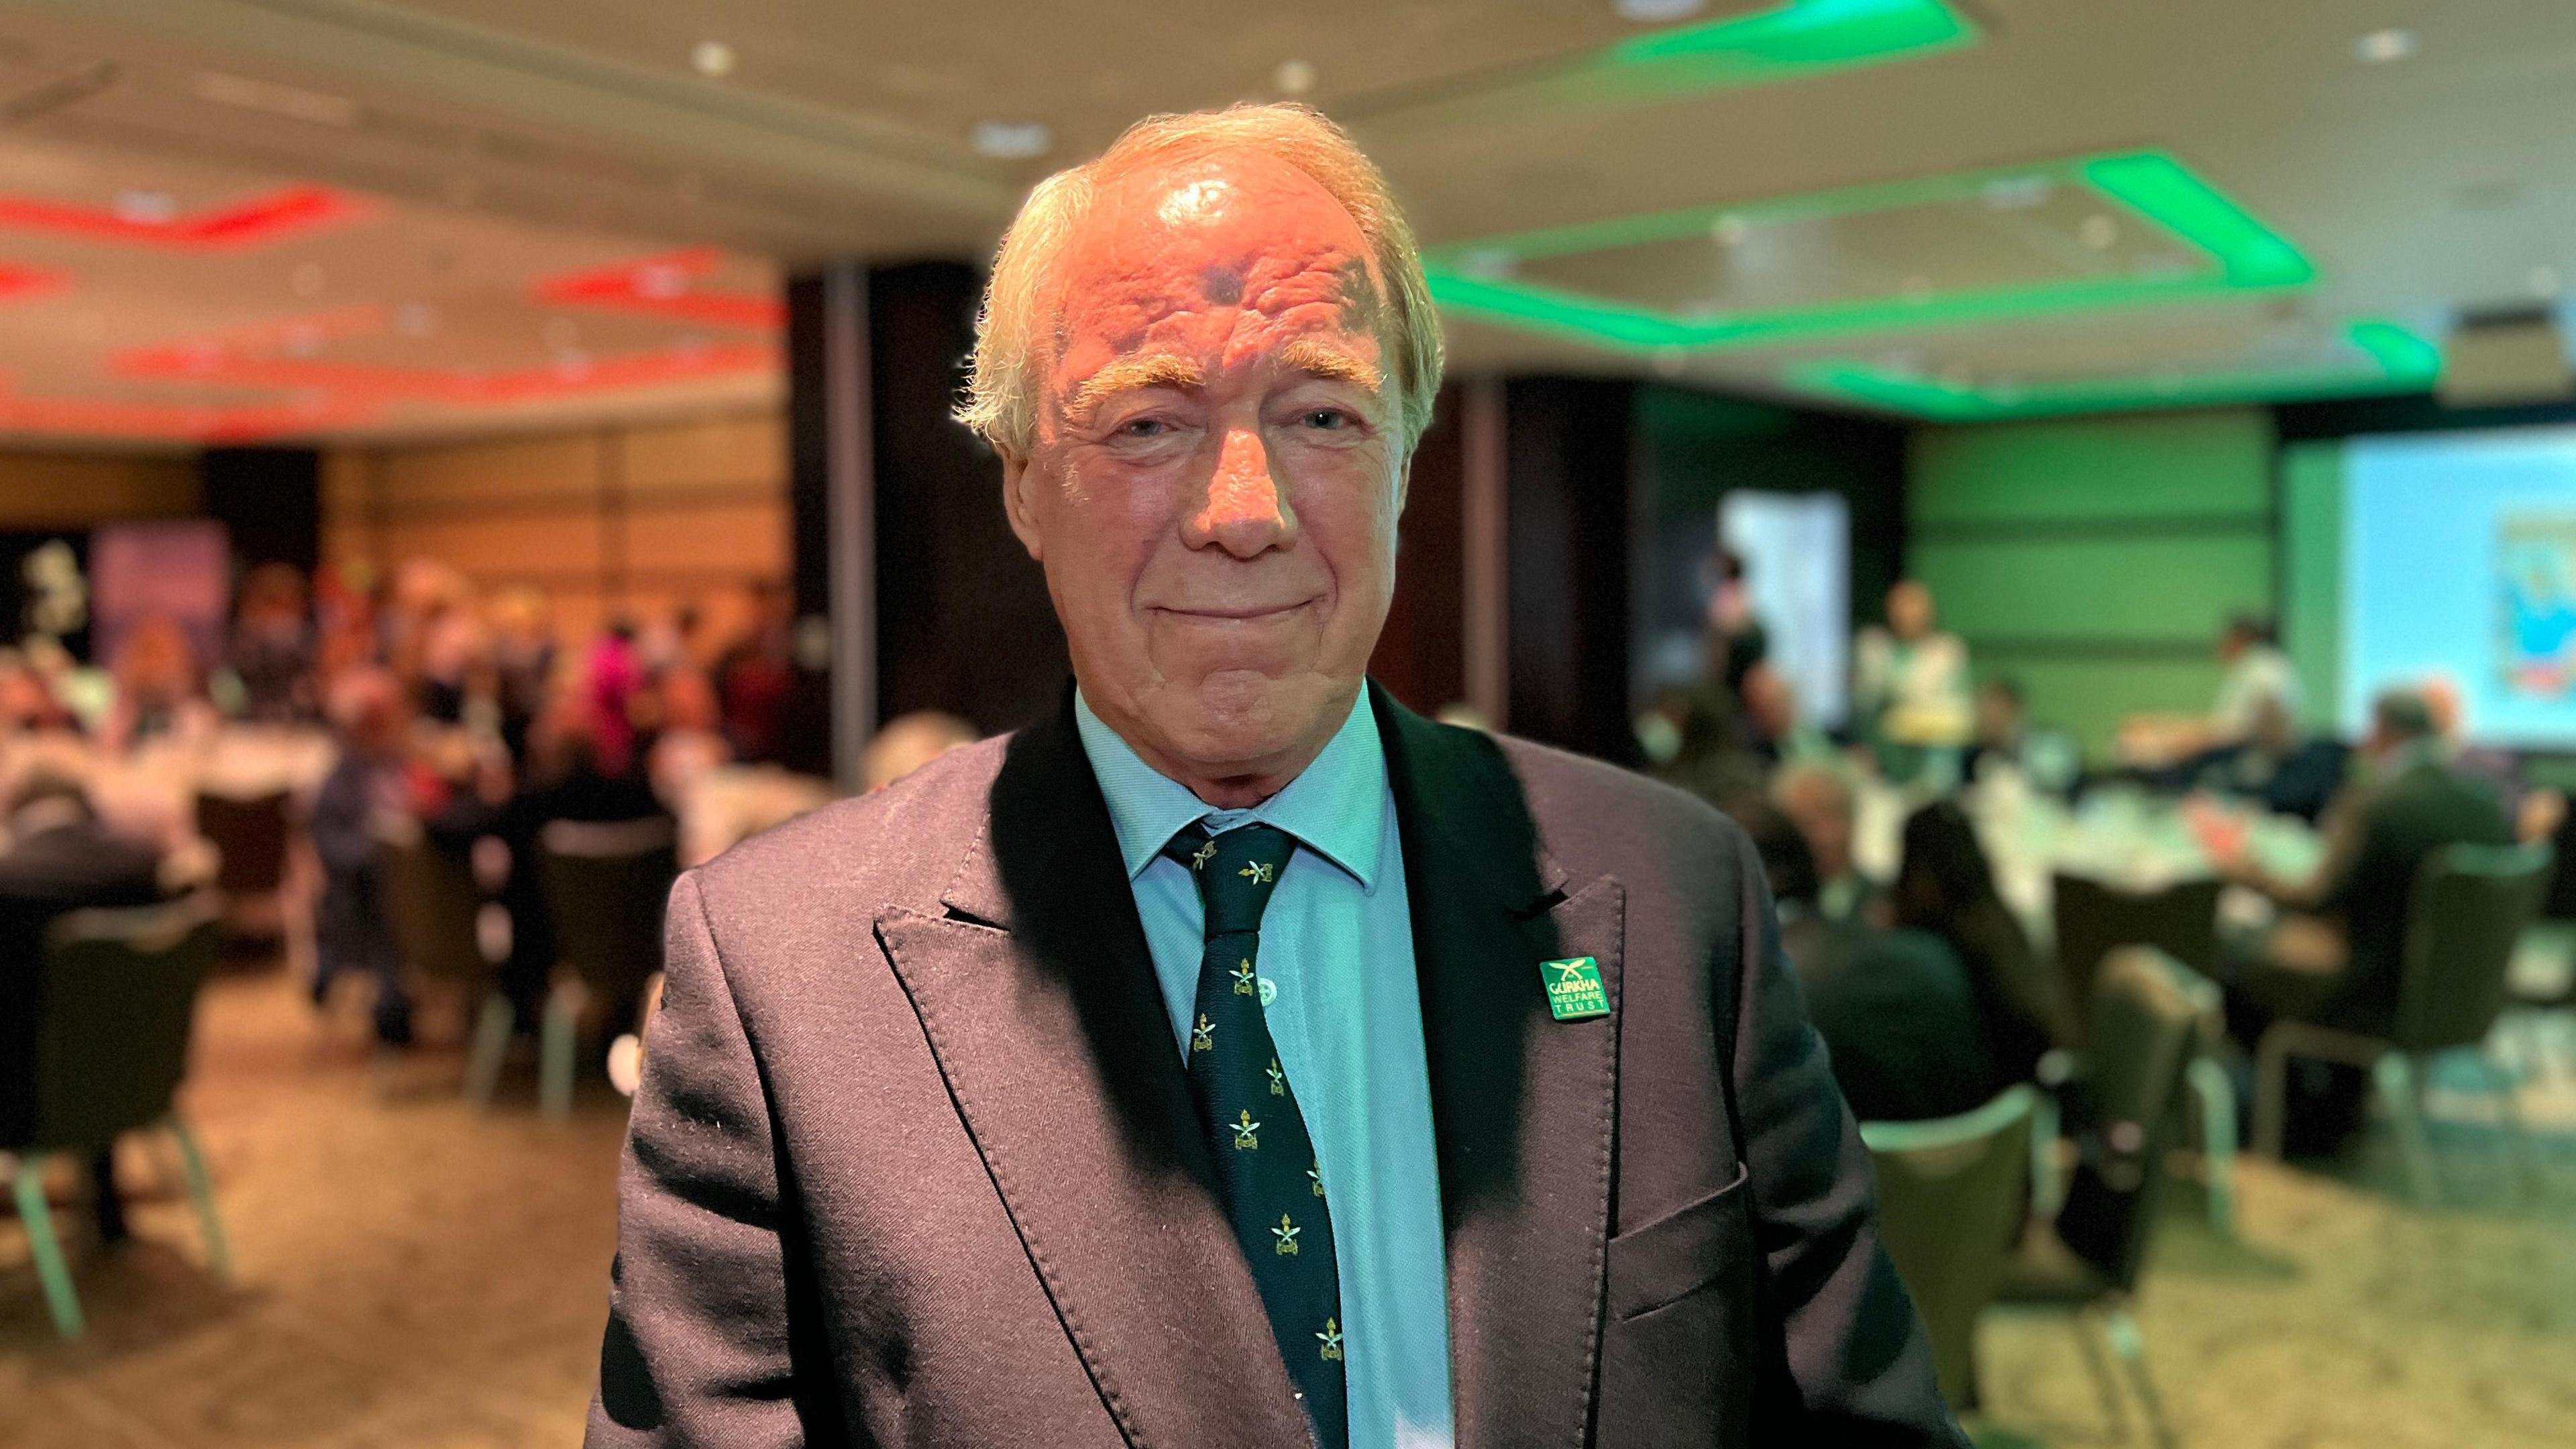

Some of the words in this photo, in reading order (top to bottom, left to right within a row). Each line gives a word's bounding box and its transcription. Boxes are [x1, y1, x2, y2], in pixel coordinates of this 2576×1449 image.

[1549, 979, 1600, 995] GURKHA
[1553, 991, 1603, 1004] WELFARE
[1555, 1000, 1604, 1013] TRUST
